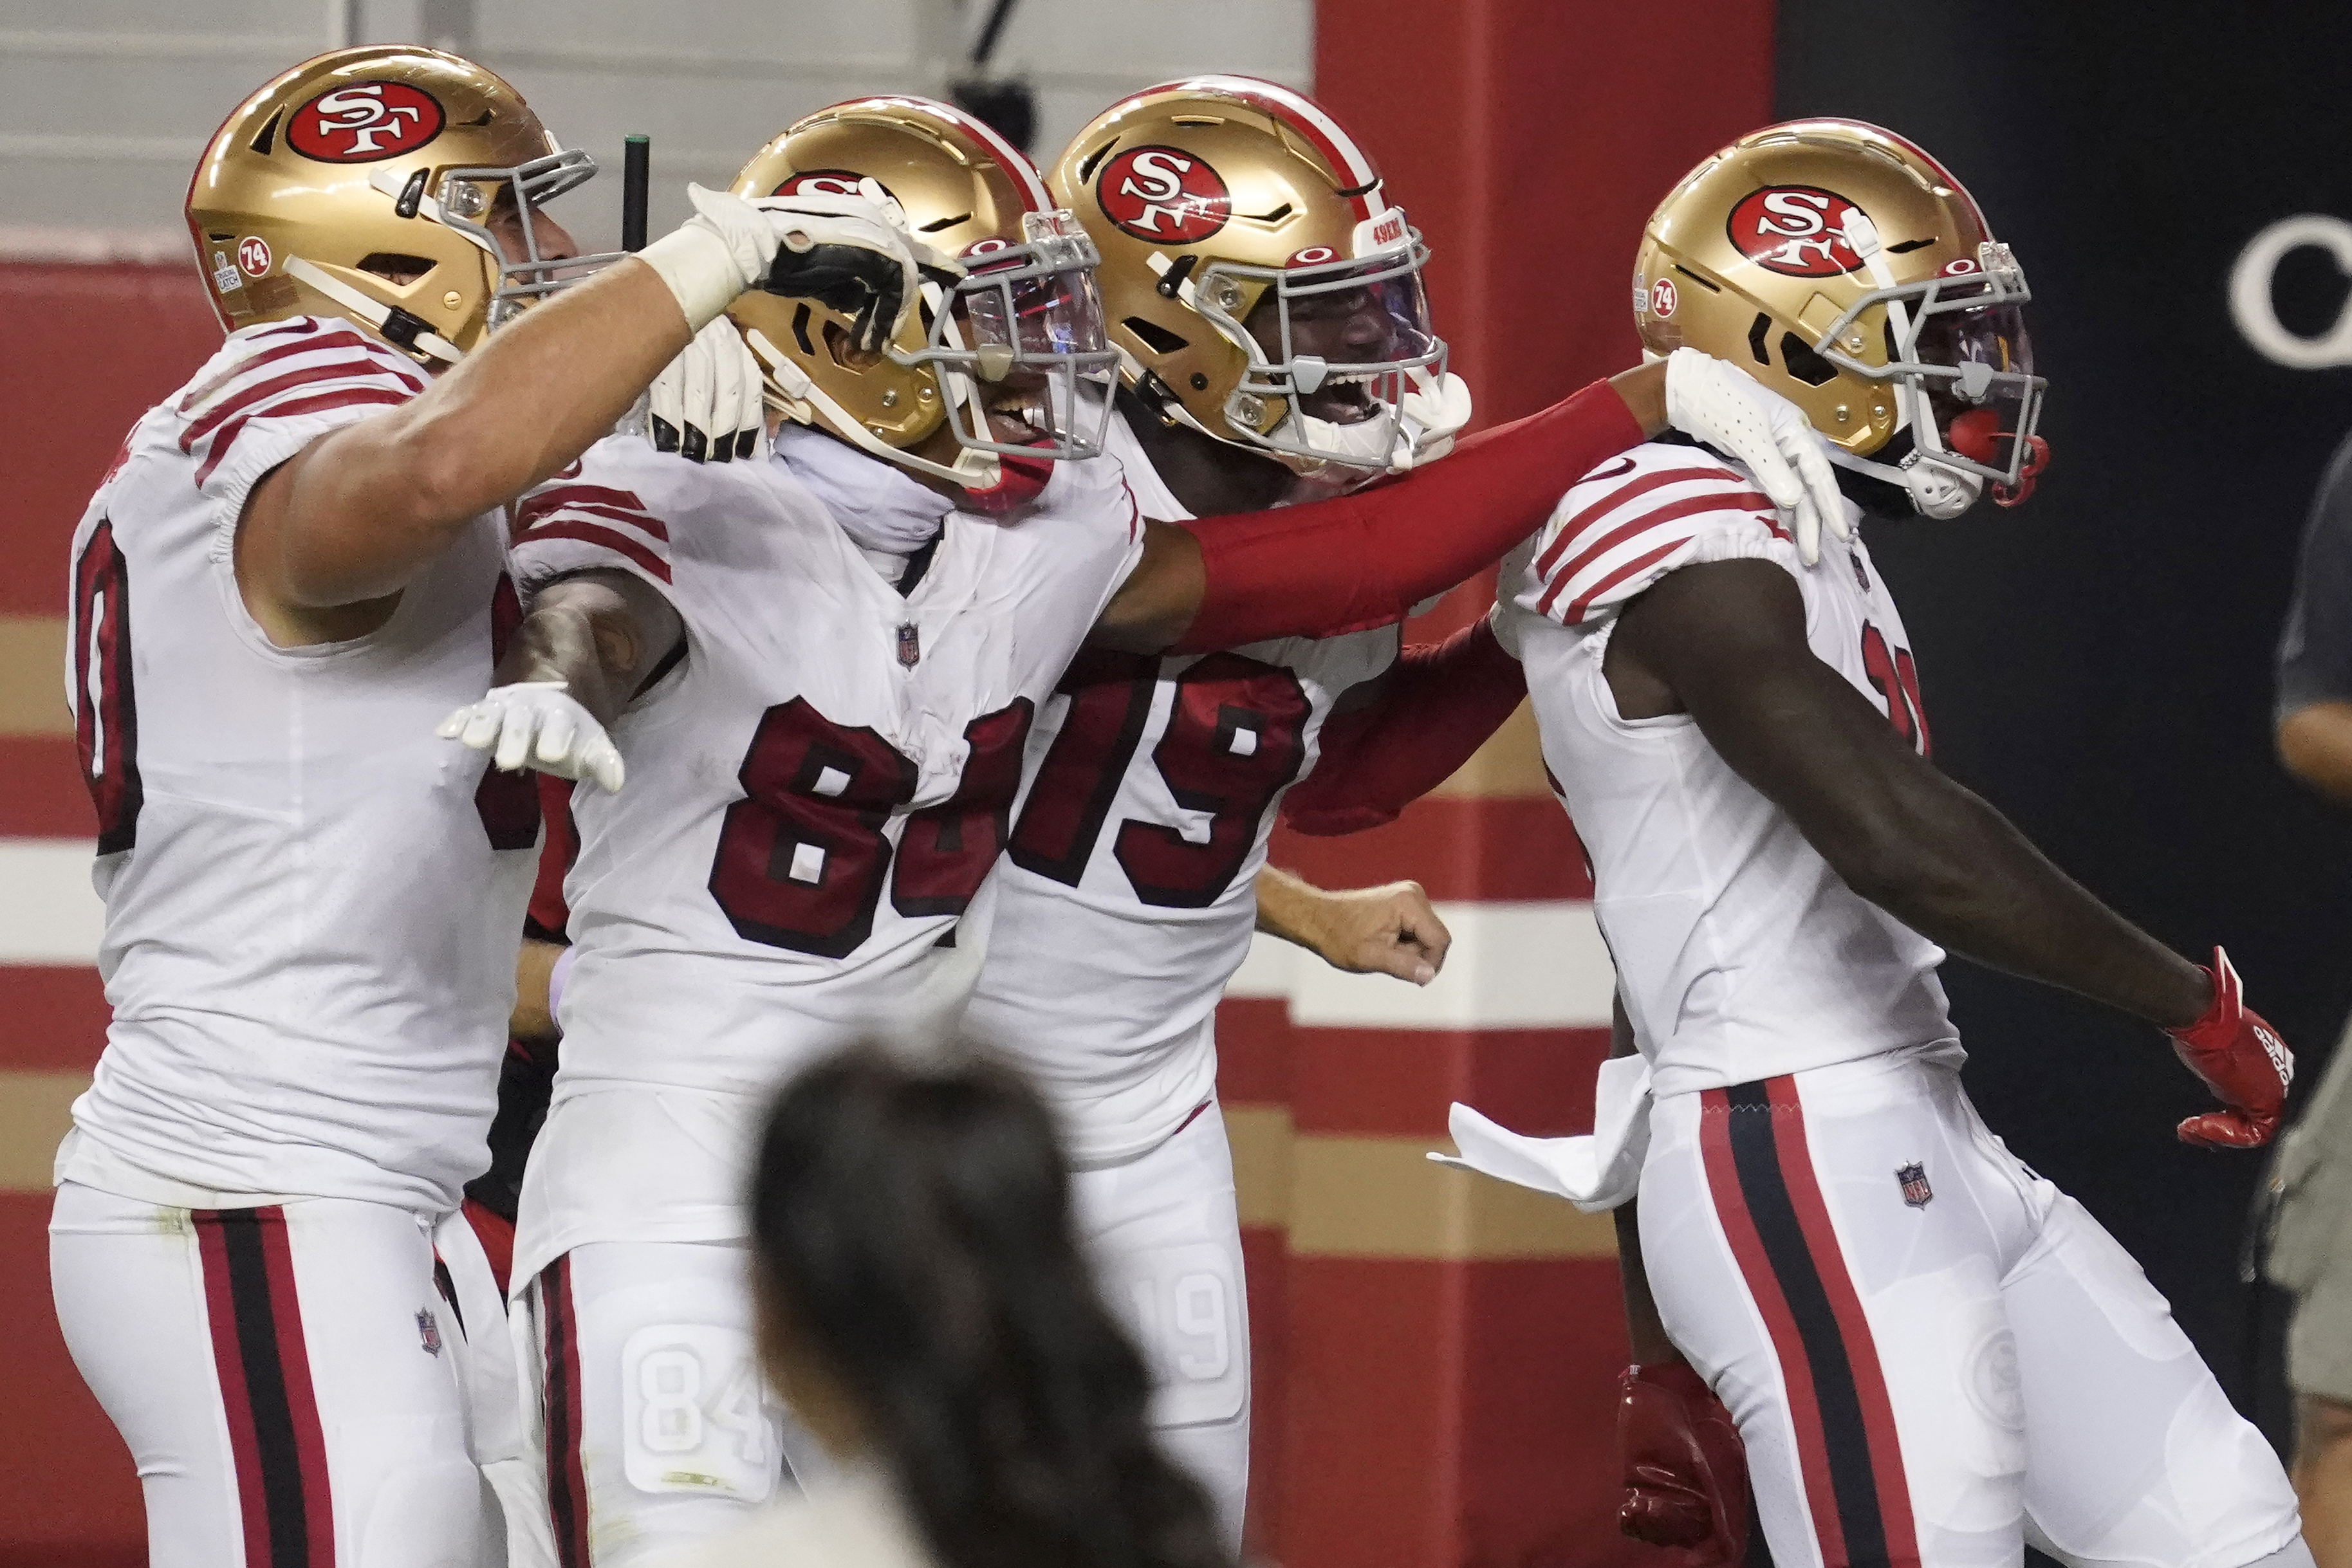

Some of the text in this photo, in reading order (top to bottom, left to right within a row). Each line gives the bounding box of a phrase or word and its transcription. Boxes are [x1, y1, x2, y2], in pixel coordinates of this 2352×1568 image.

[316, 84, 419, 154] SF
[1120, 152, 1208, 232] SF
[241, 243, 268, 270] 74
[1656, 286, 1672, 310] 74
[1006, 651, 1311, 909] 19
[707, 694, 1035, 959] 84
[640, 1350, 766, 1465] 84
